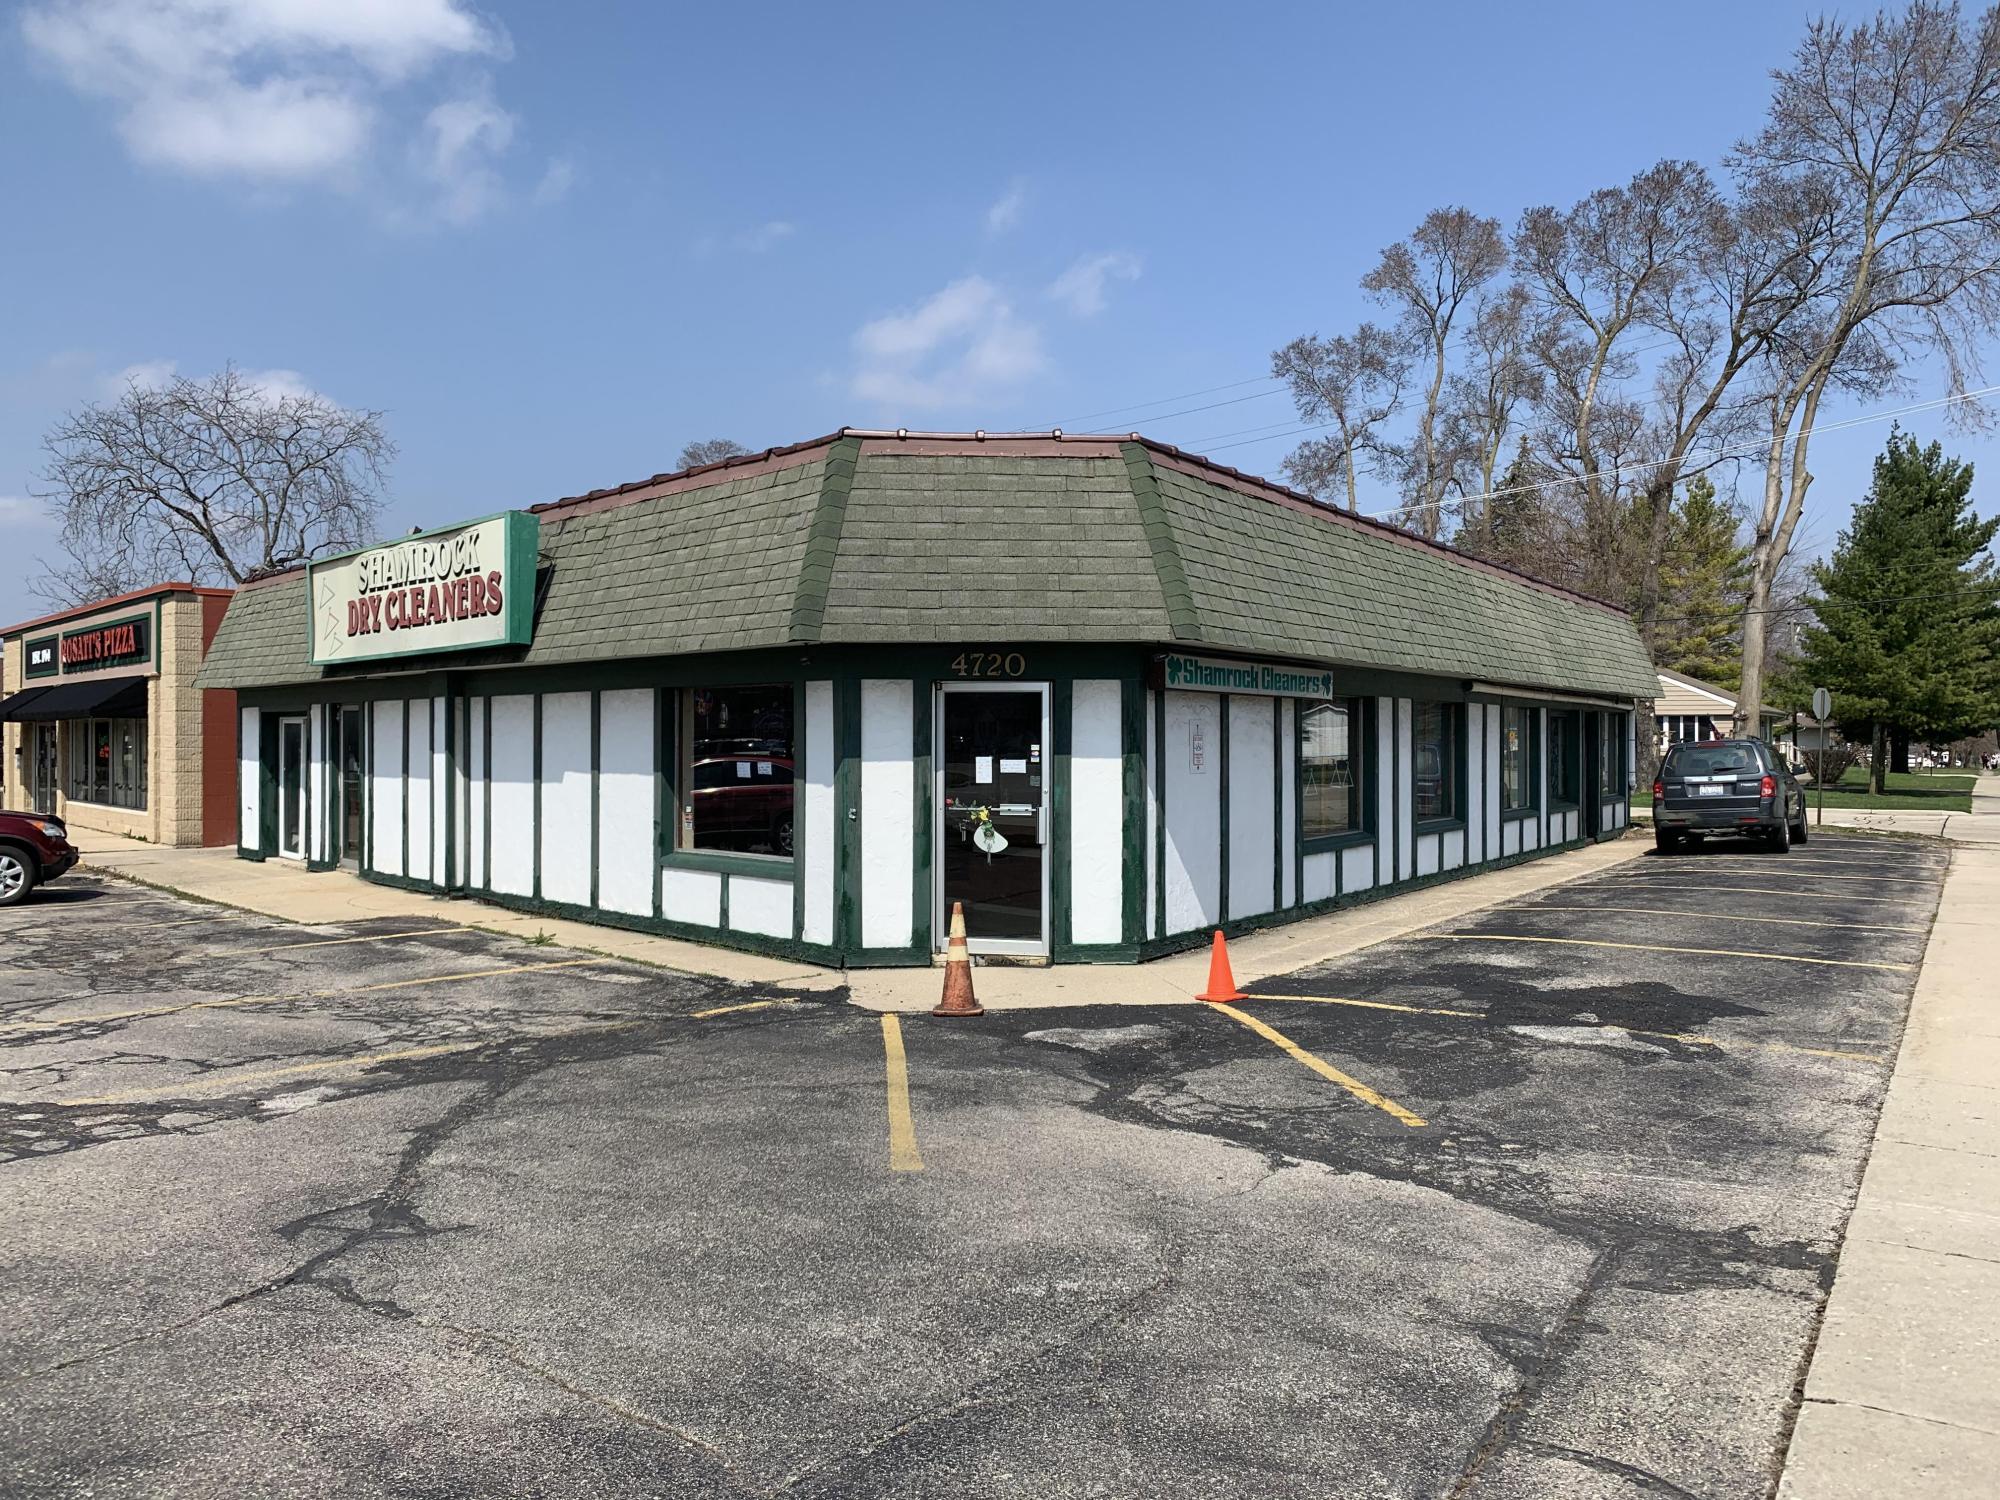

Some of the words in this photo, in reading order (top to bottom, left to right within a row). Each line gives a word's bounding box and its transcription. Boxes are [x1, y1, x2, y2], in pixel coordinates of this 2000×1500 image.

[358, 529, 482, 594] SHAMROCK
[347, 595, 382, 637] DRY
[384, 570, 503, 630] CLEANERS
[61, 633, 101, 663] ROSATI'S
[103, 624, 136, 656] PIZZA
[951, 653, 1026, 677] 4720
[1183, 658, 1258, 689] Shamrock
[1261, 666, 1320, 693] Cleaners
